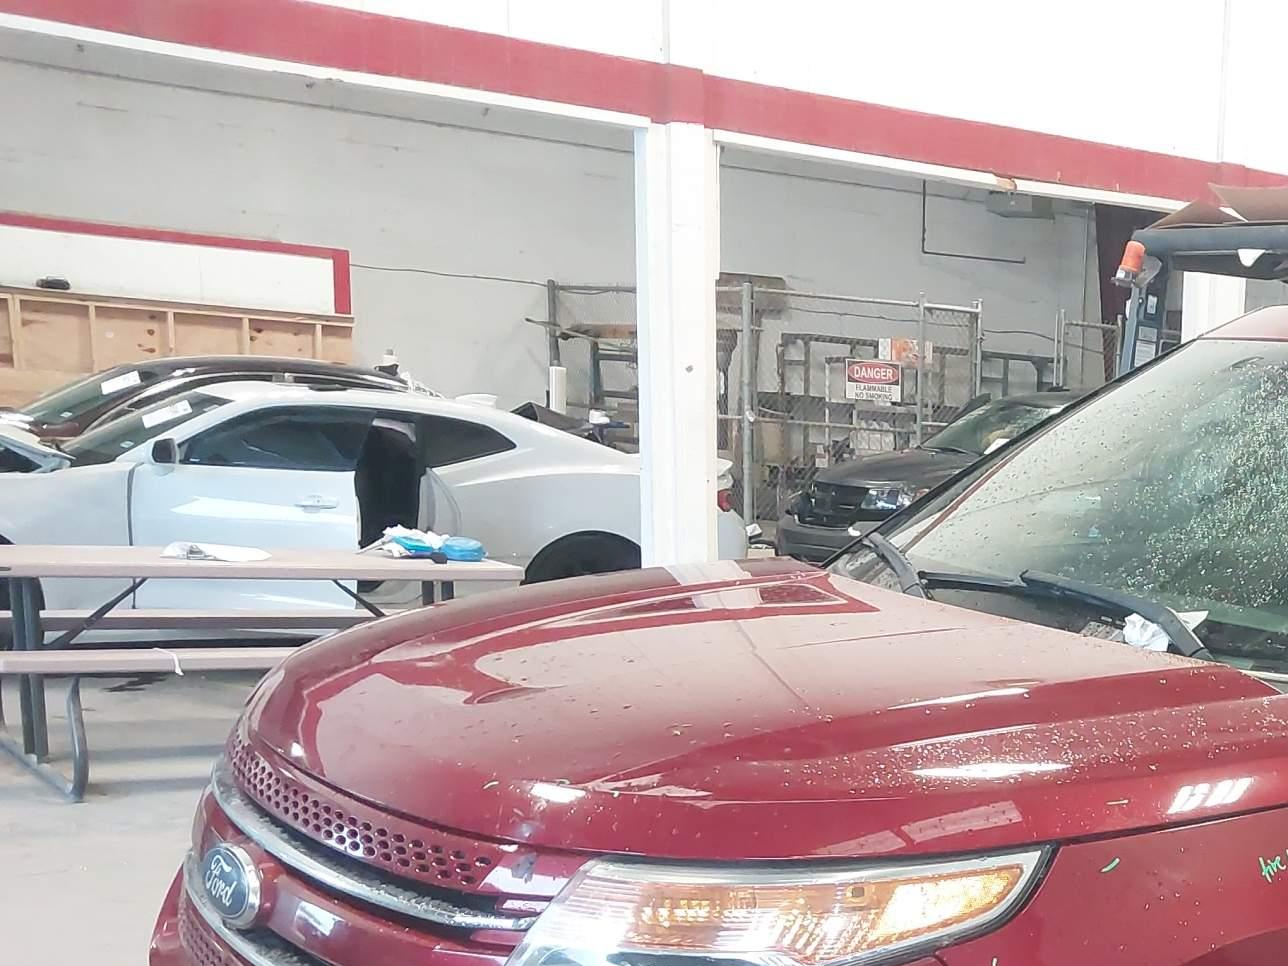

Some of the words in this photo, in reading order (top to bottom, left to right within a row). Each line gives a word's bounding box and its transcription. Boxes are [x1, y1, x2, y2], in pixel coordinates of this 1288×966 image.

[854, 366, 893, 380] DANGER
[855, 384, 892, 393] FLAMMABLE
[865, 393, 893, 401] SMOKING
[205, 855, 237, 907] Ford
